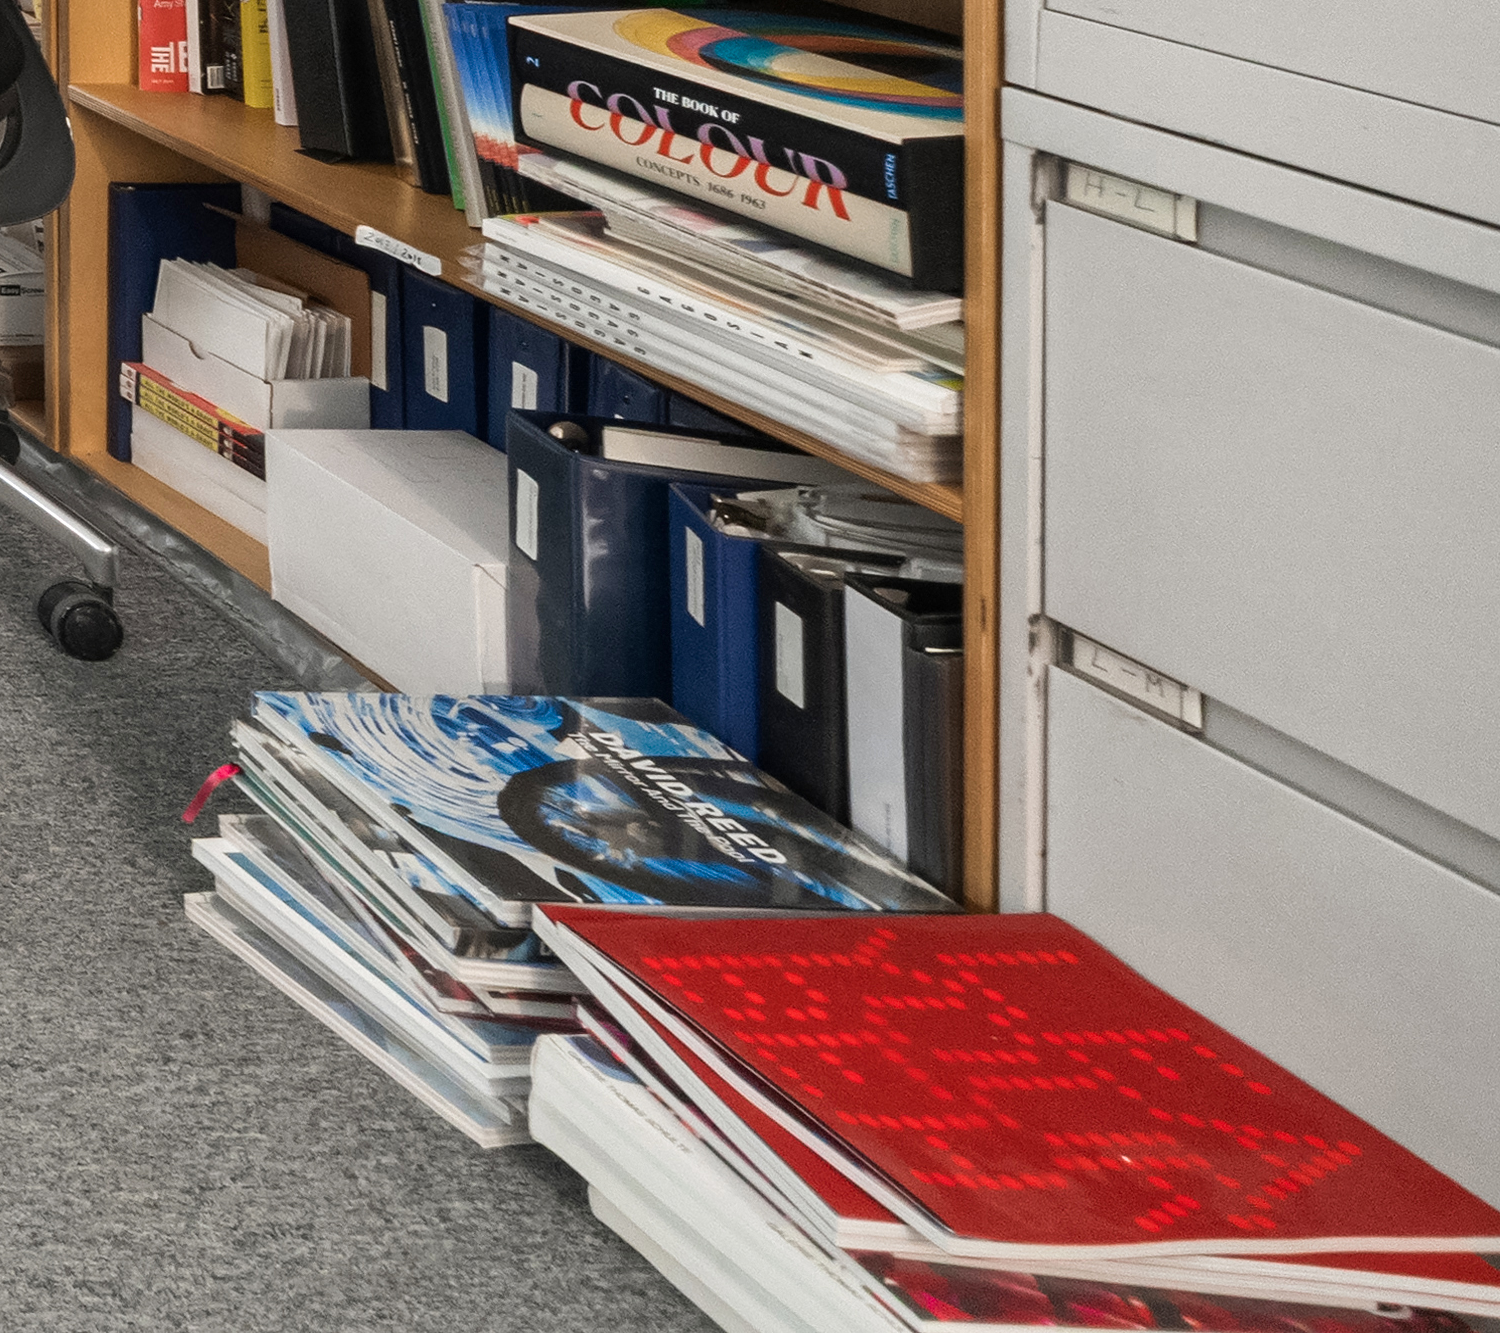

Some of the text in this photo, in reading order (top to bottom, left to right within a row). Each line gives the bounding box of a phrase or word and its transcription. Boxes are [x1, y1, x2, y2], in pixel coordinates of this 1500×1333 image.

[653, 85, 741, 124] THE BOOK OF
[566, 79, 854, 223] COLOUR
[883, 155, 899, 200] TASCHEN
[636, 155, 702, 188] CONCEPTS
[739, 190, 768, 212] 1963
[589, 730, 787, 867] DAVID REED
